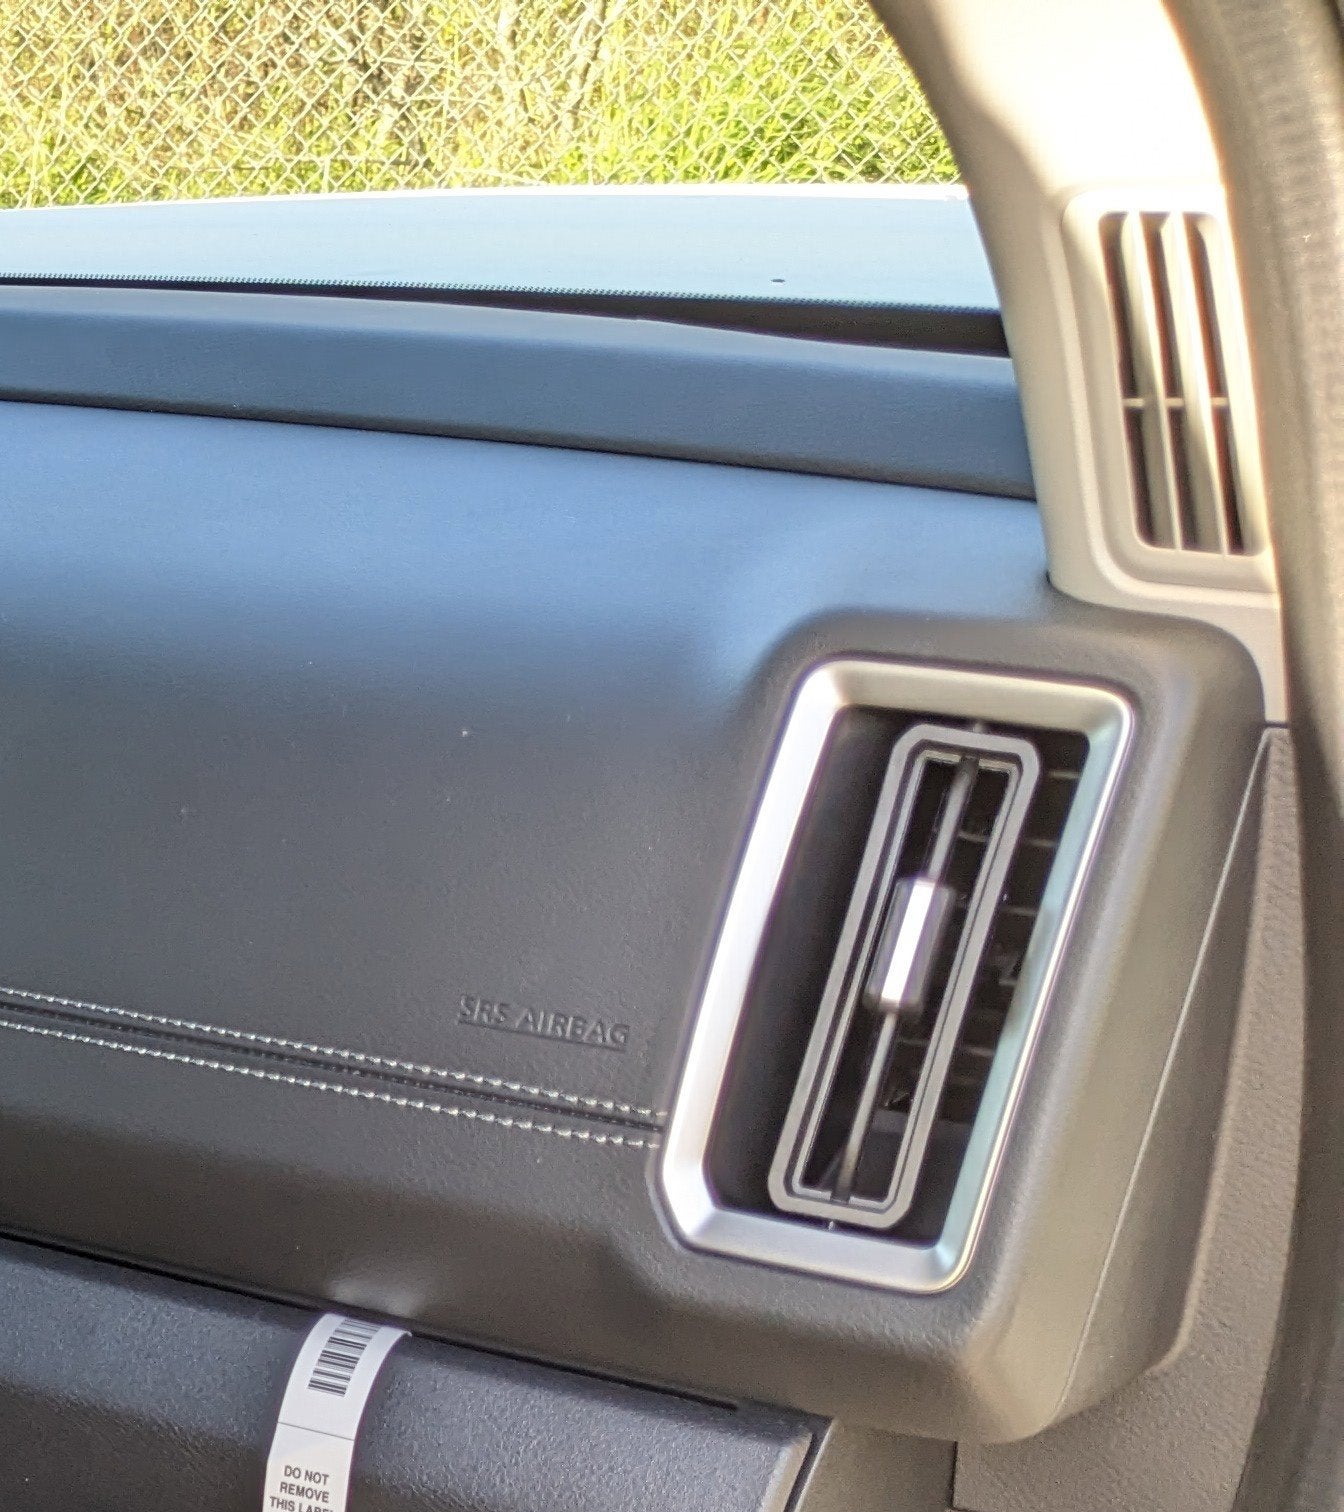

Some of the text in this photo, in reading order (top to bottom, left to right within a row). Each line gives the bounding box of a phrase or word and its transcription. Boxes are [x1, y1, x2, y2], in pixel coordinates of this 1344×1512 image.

[514, 1006, 631, 1046] AIRBAG
[284, 1464, 330, 1486] DO NOT
[269, 1496, 295, 1512] THIS
[279, 1482, 330, 1504] REMOVE
